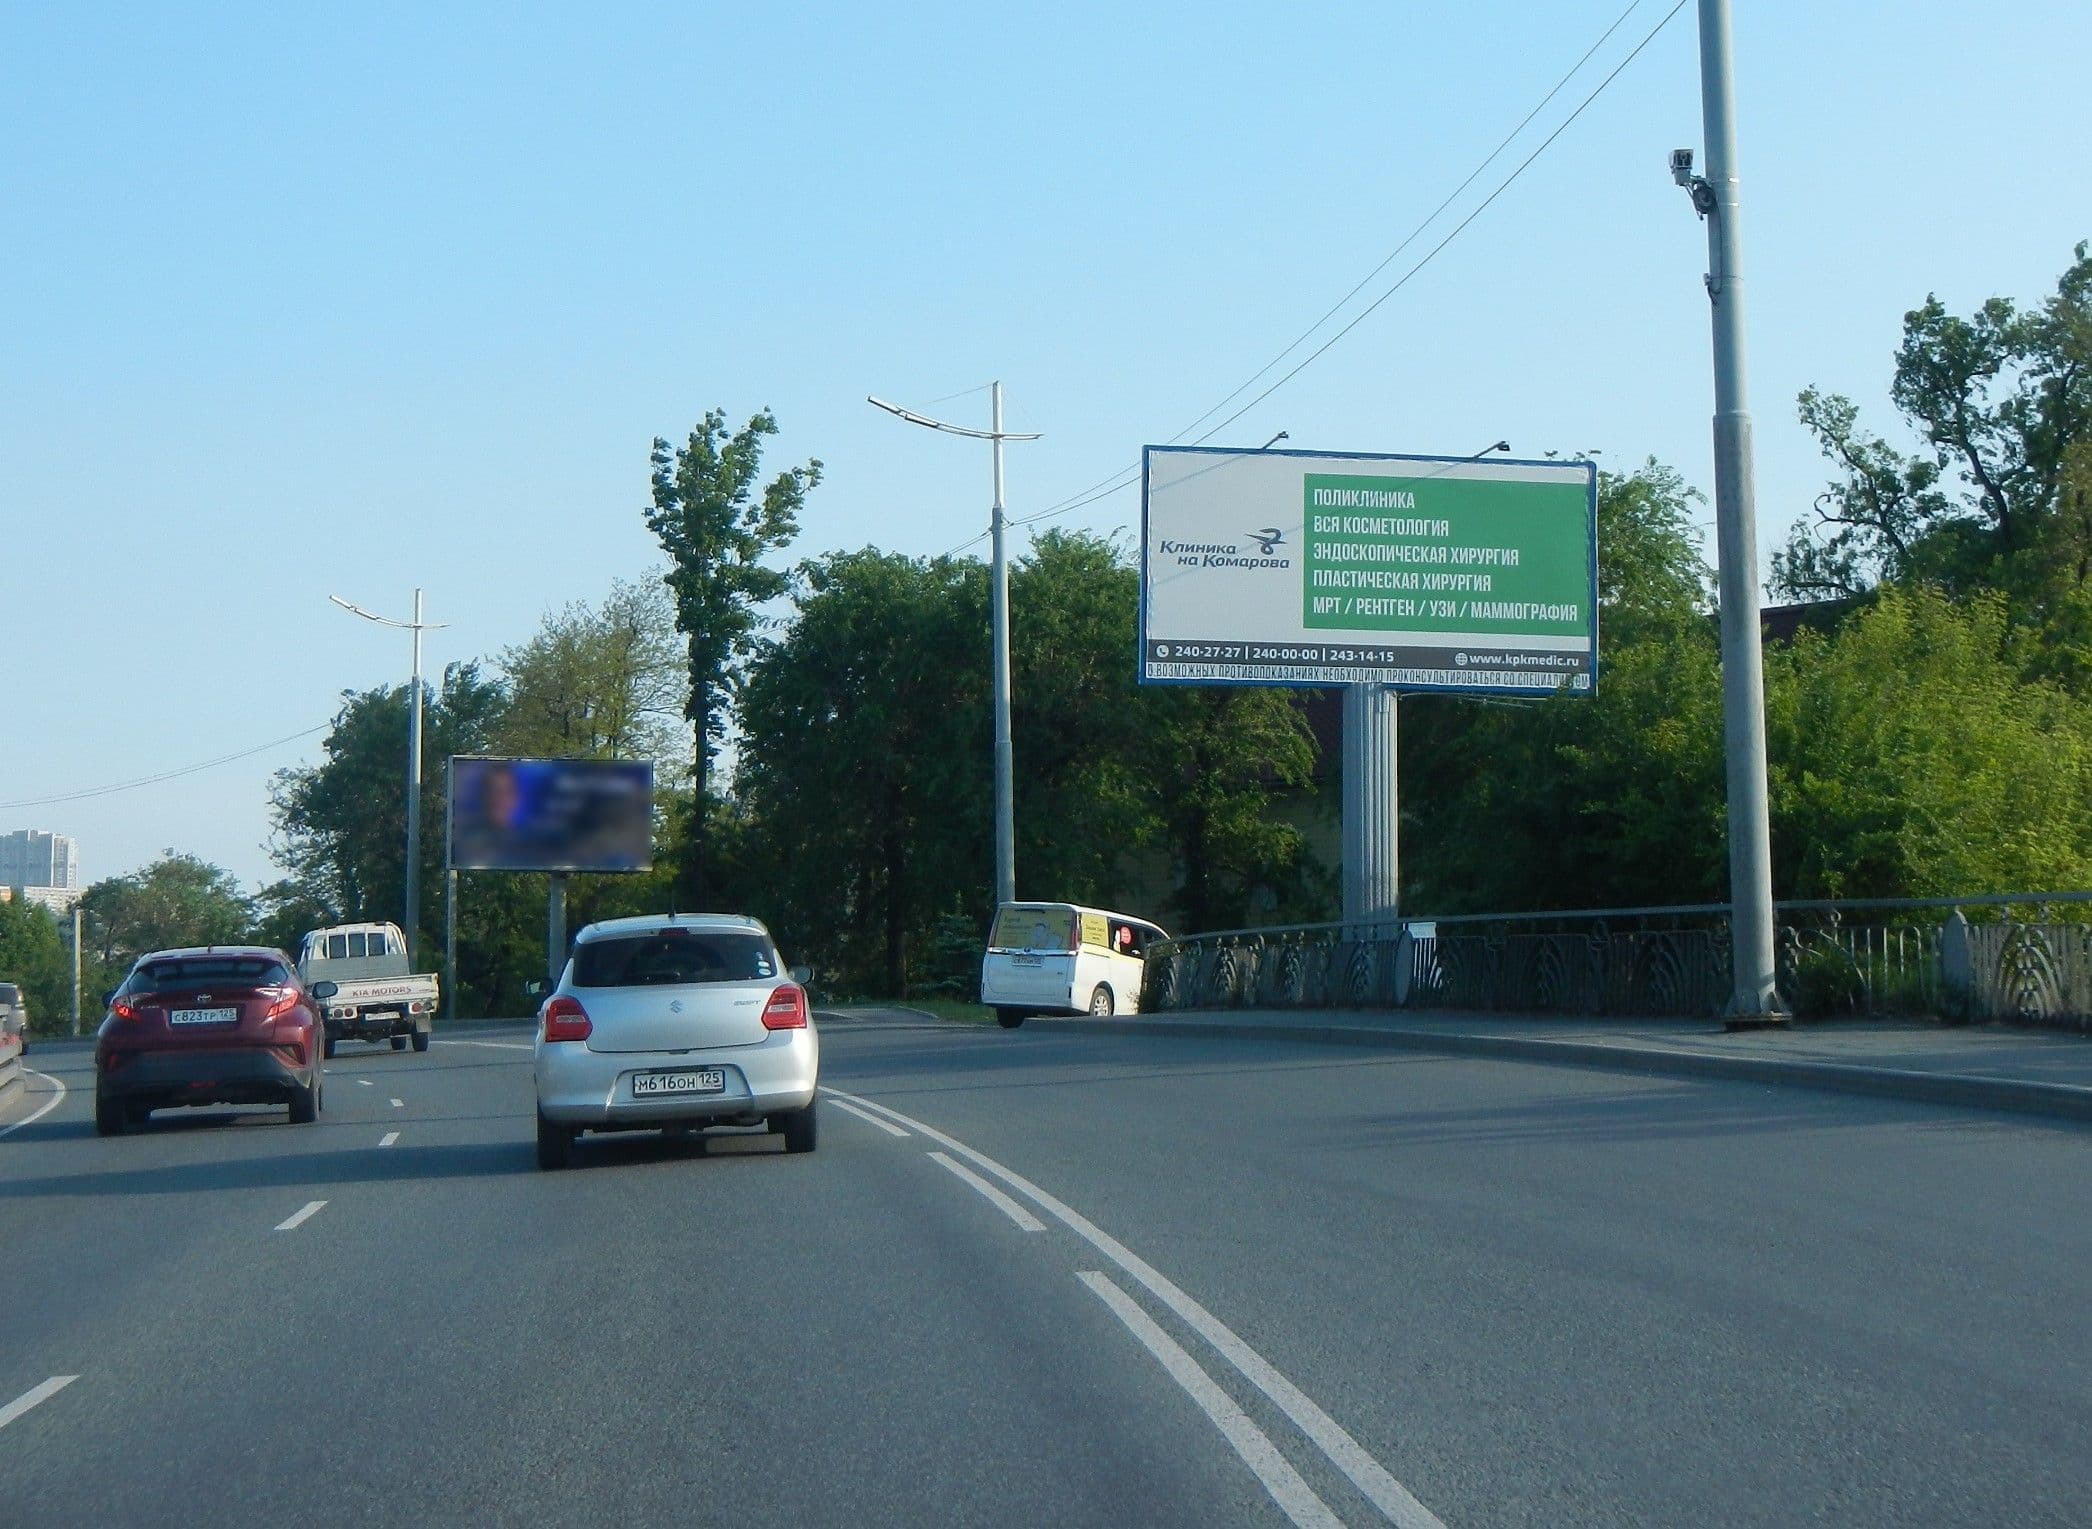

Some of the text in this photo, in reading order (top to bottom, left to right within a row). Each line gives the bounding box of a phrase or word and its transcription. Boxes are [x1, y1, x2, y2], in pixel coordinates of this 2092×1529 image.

[1314, 488, 1415, 508] ПОЛИКЛИНИКА
[1313, 515, 1449, 536] ВСЯ КОСМЕТОЛОГИЯ
[1160, 540, 1236, 555] Клиника
[1313, 542, 1519, 566] ЭНДОСКОПИЧЕСКАЯ ХИРУРГИЯ
[1177, 554, 1289, 570] на Комарова
[1313, 569, 1491, 592] ПЛАСТИЧЕСКАЯ ХИРУРГИЯ
[1313, 596, 1341, 614] МРТ
[1356, 597, 1414, 616] РЕНТГЕН
[1430, 600, 1456, 617] УЗИ
[1471, 601, 1578, 621] МАММОГРАФИЯ
[1175, 646, 1579, 667] 240-27-27 240-00-00 243-14-15 www.kpkmedic.ru
[1156, 664, 1216, 678] ВОЗМОЖНЫХ
[1322, 668, 1383, 681] НЕОБХОДИМО
[352, 986, 412, 997] KIA MOTORS
[639, 1072, 720, 1091] М616ОН 125
